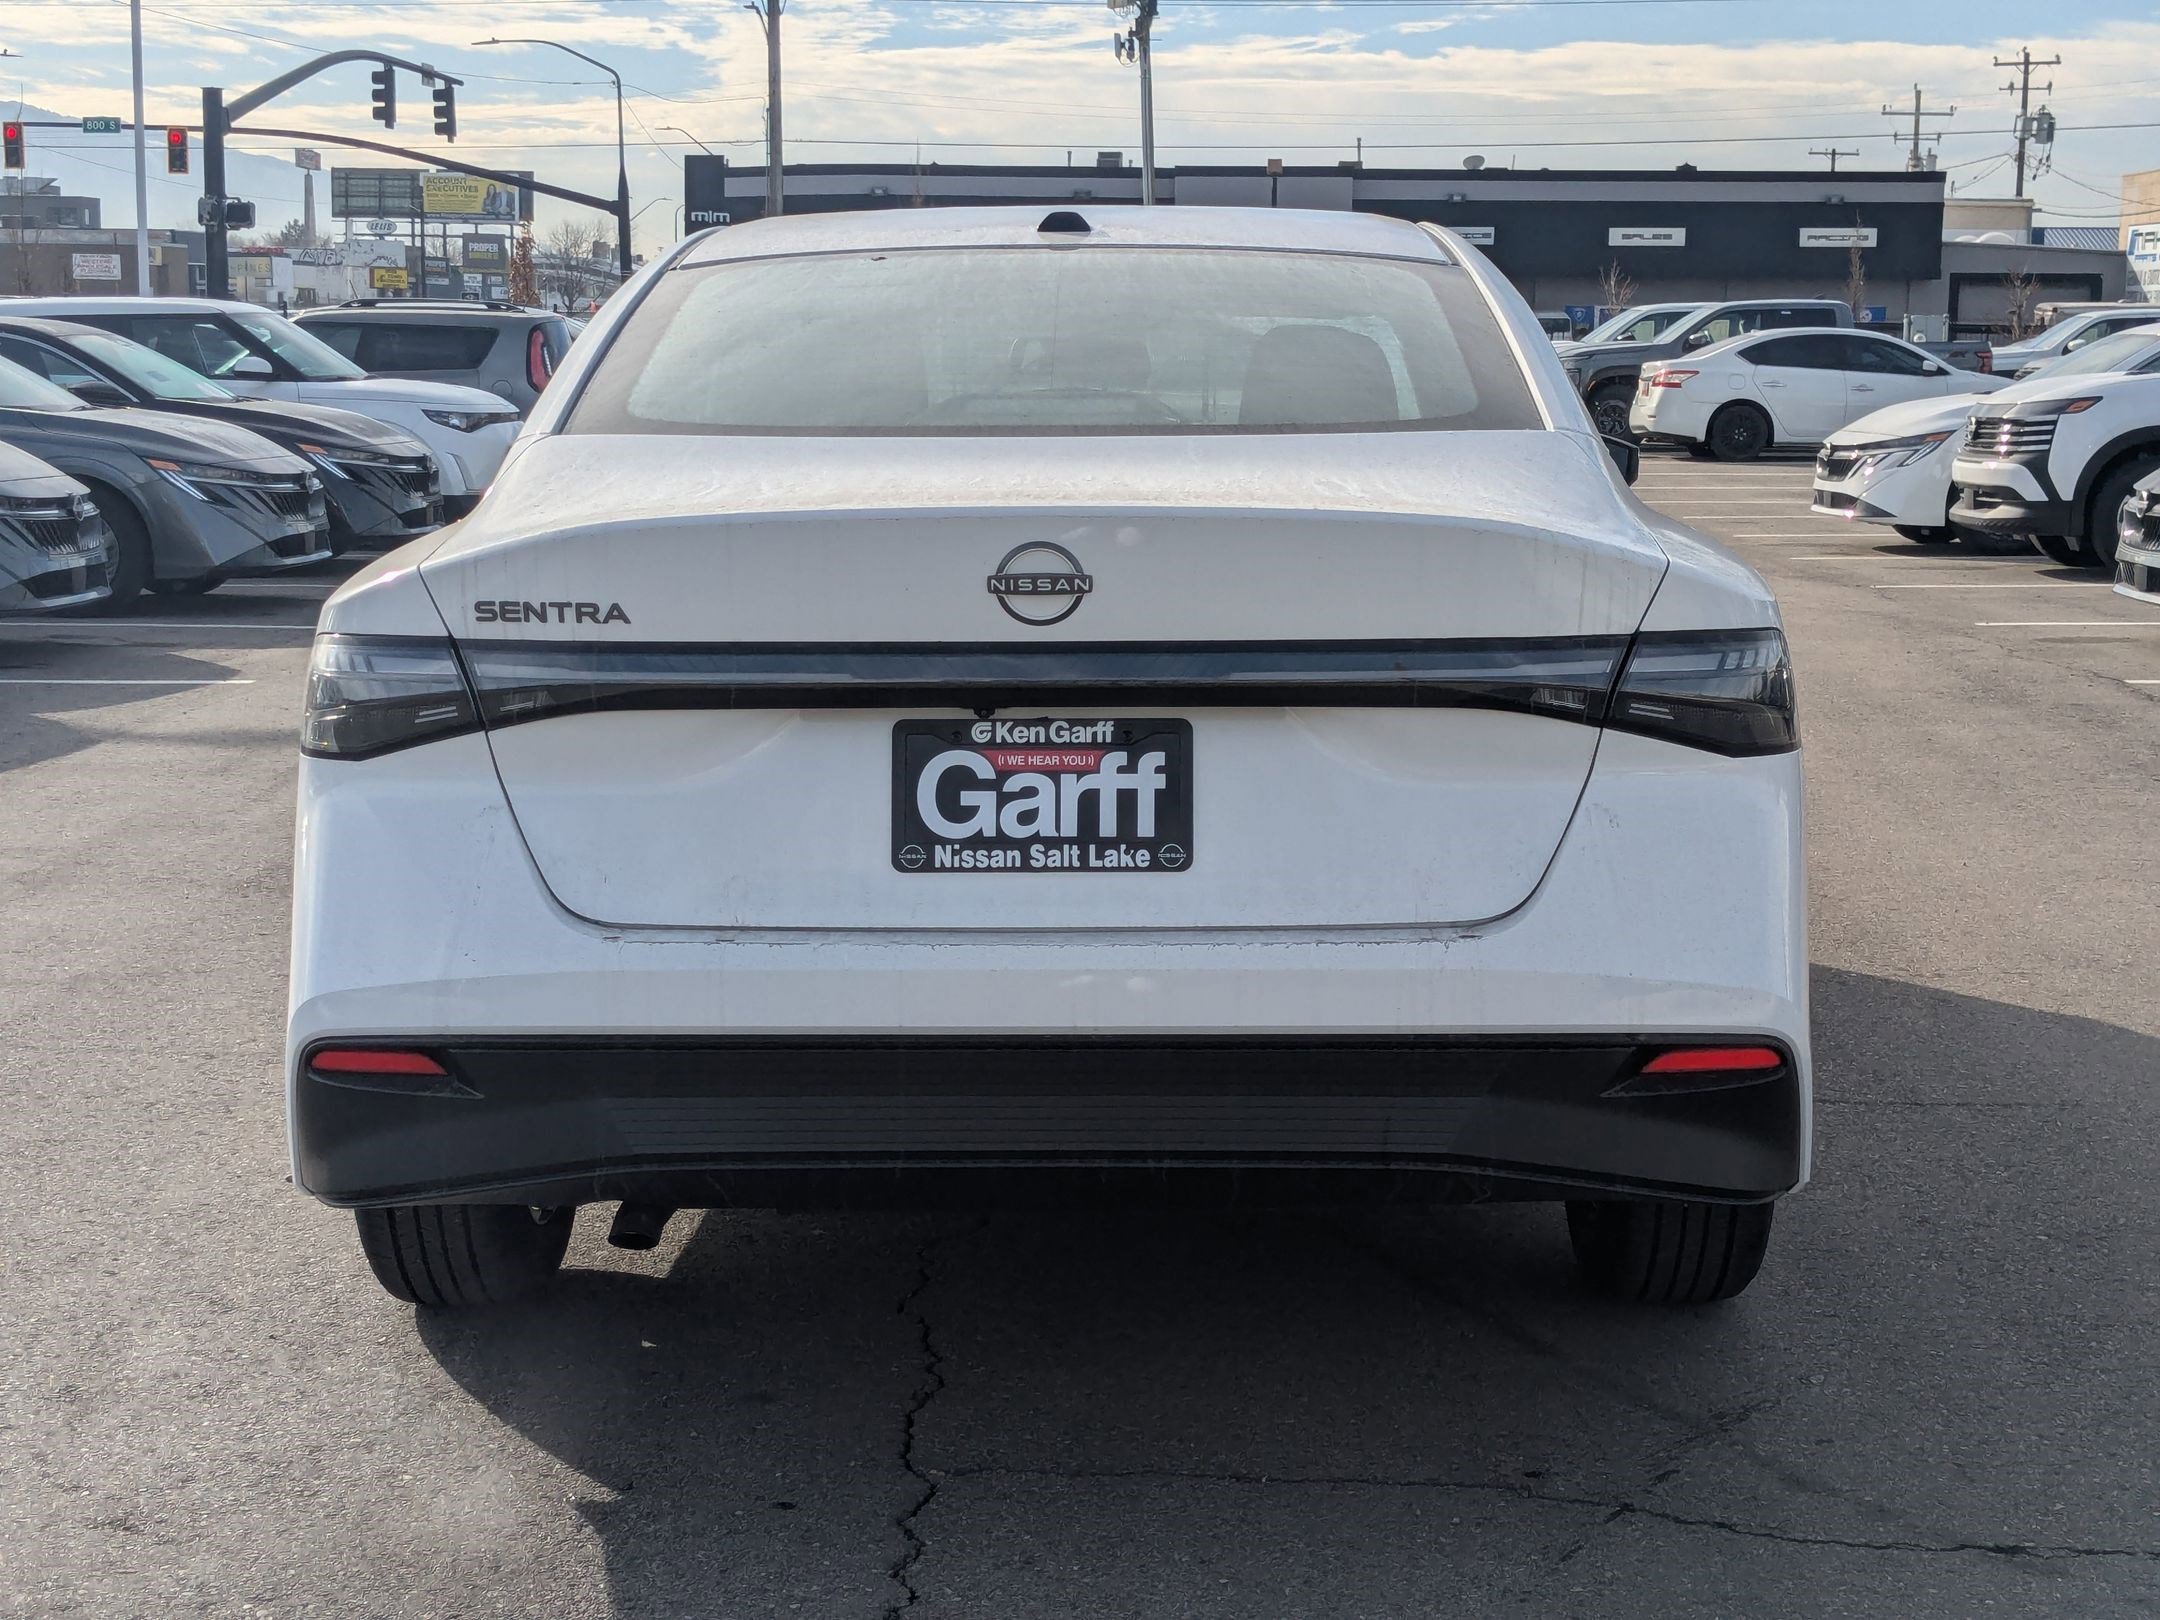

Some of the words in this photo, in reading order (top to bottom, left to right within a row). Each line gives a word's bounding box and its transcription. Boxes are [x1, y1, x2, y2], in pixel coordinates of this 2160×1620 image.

[86, 120, 105, 130] 800
[110, 120, 116, 130] S
[426, 176, 467, 185] ACCOUNT
[426, 185, 478, 194] EXECUTIVES
[989, 577, 1091, 592] NISSAN
[474, 601, 631, 625] SENTRA
[996, 721, 1045, 743] Ken
[1049, 720, 1114, 743] Garff
[1006, 754, 1026, 766] WE
[1028, 754, 1060, 766] HEAR
[1062, 754, 1087, 767] YOU
[917, 750, 1166, 839] Garff
[934, 844, 1021, 868] Nissan
[1029, 844, 1081, 868] Salt
[1088, 844, 1151, 868] Lake
